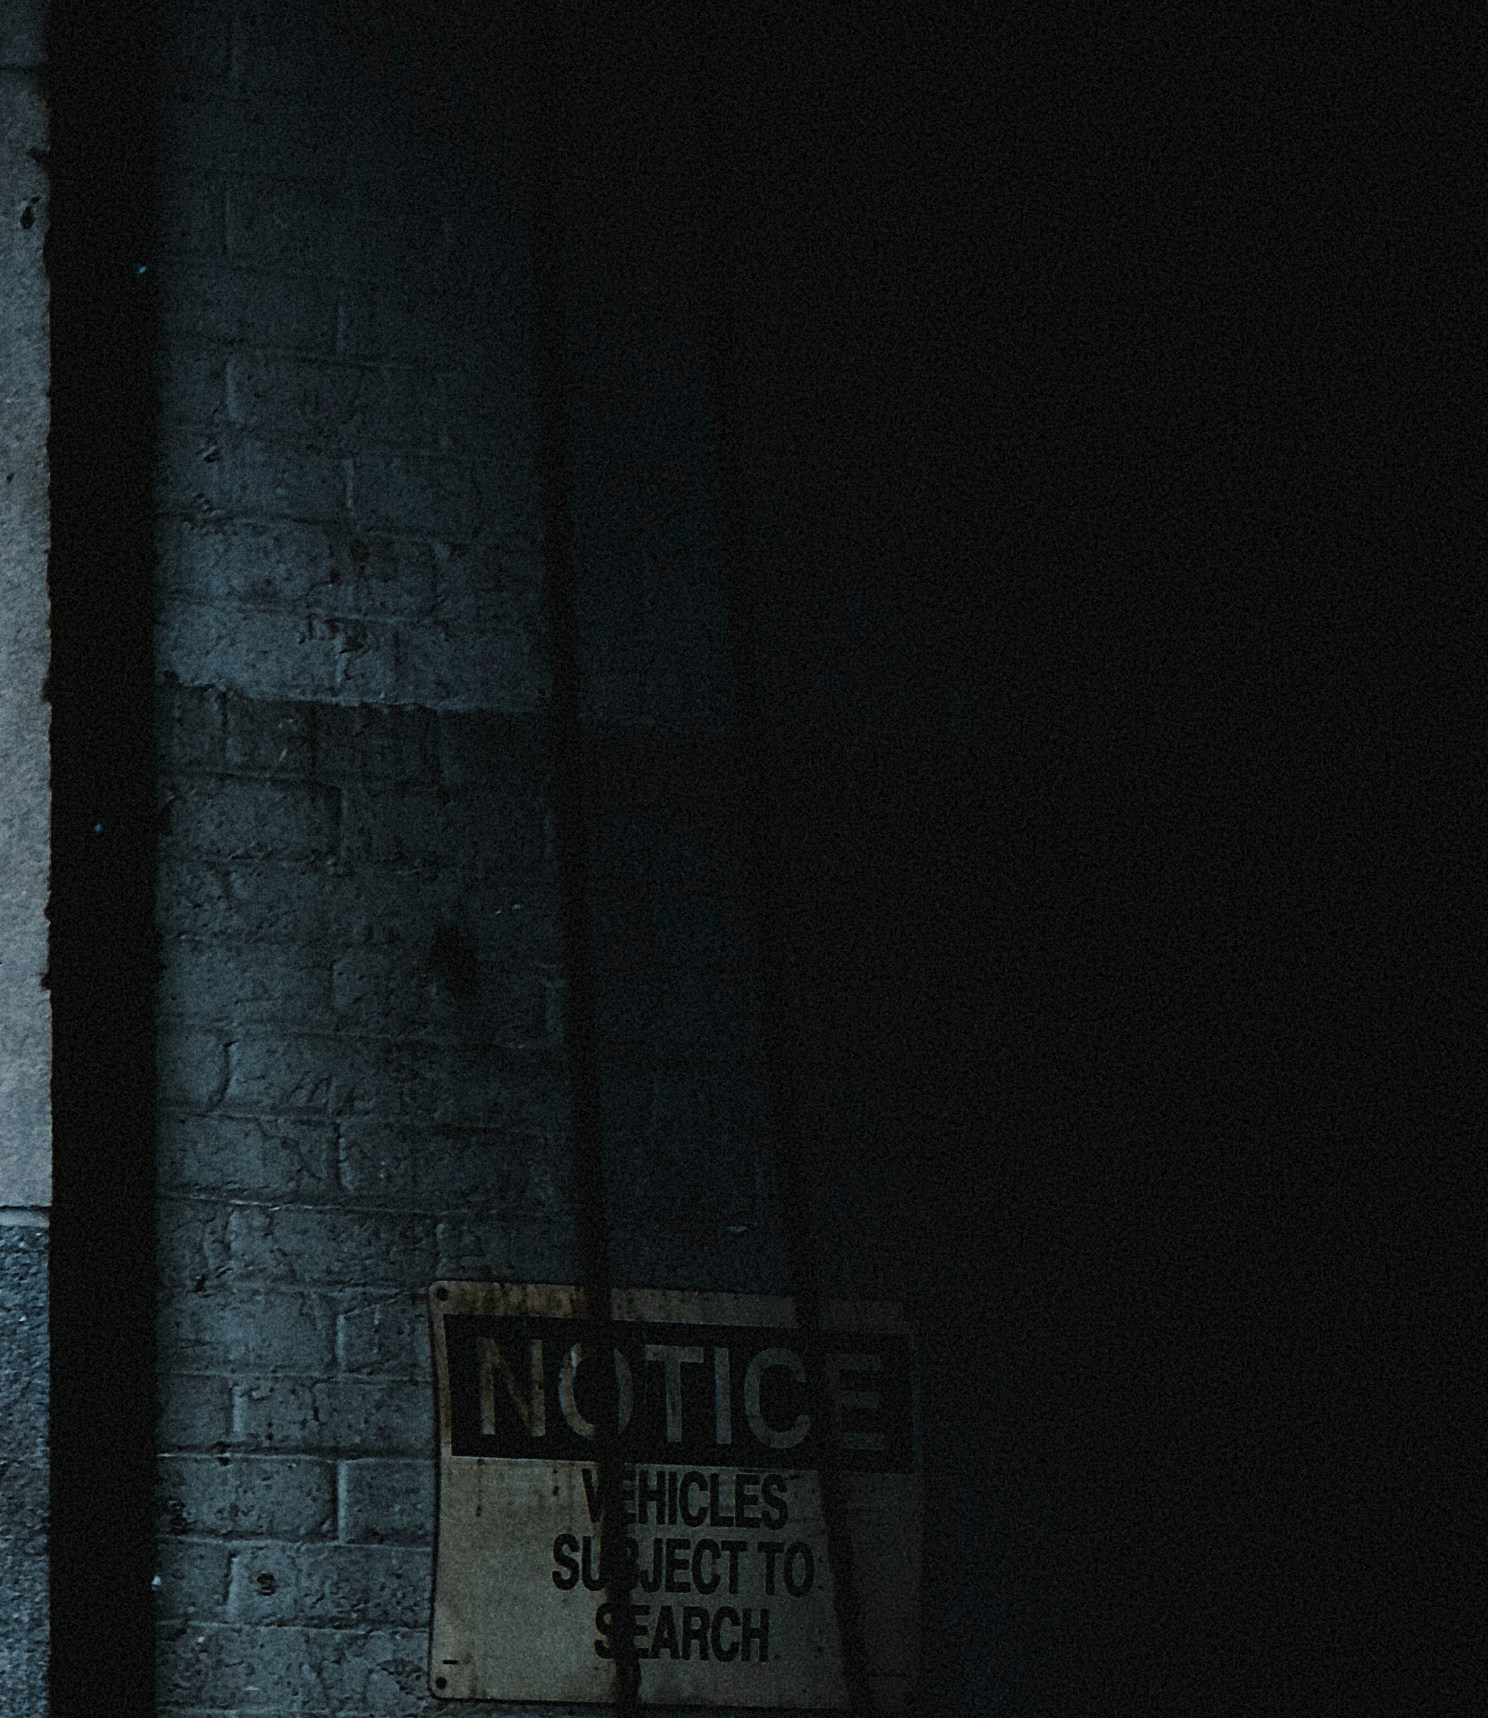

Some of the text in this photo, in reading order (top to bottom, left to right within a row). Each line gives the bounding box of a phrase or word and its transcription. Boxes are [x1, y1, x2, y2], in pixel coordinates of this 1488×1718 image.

[477, 1336, 886, 1452] NOTICE
[757, 1541, 816, 1598] TO
[594, 1602, 770, 1663] SEARCH
